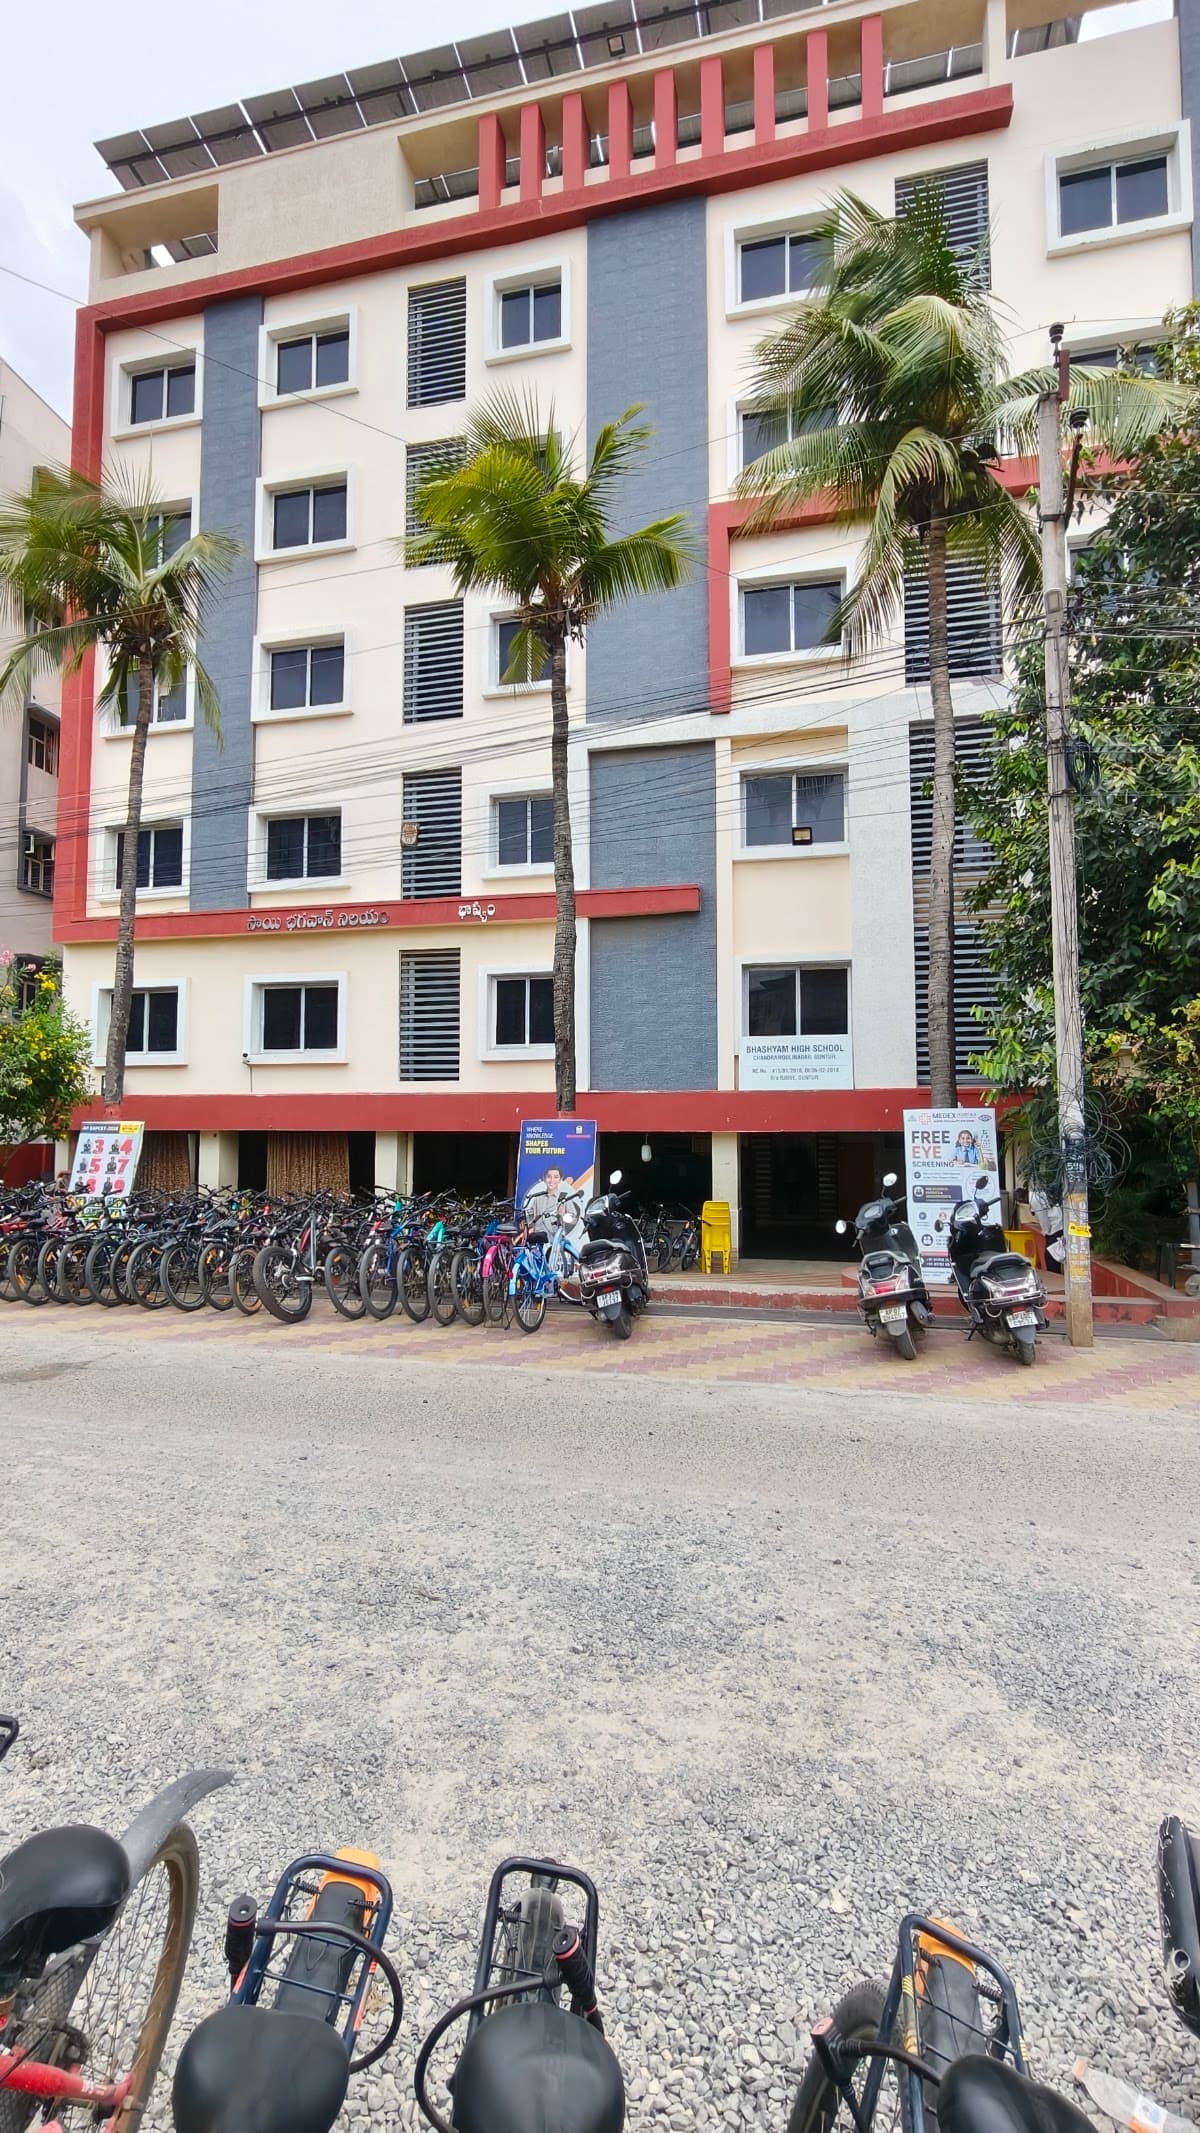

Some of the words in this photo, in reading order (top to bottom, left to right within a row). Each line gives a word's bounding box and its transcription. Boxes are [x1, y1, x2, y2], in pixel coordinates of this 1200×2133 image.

[747, 1045, 789, 1053] BHASHYAM
[791, 1045, 810, 1053] HIGH
[812, 1044, 844, 1052] SCHOOL
[912, 1130, 950, 1144] FREE
[911, 1146, 942, 1159] EYE
[118, 1160, 129, 1174] 7
[912, 1159, 955, 1168] SCREENING
